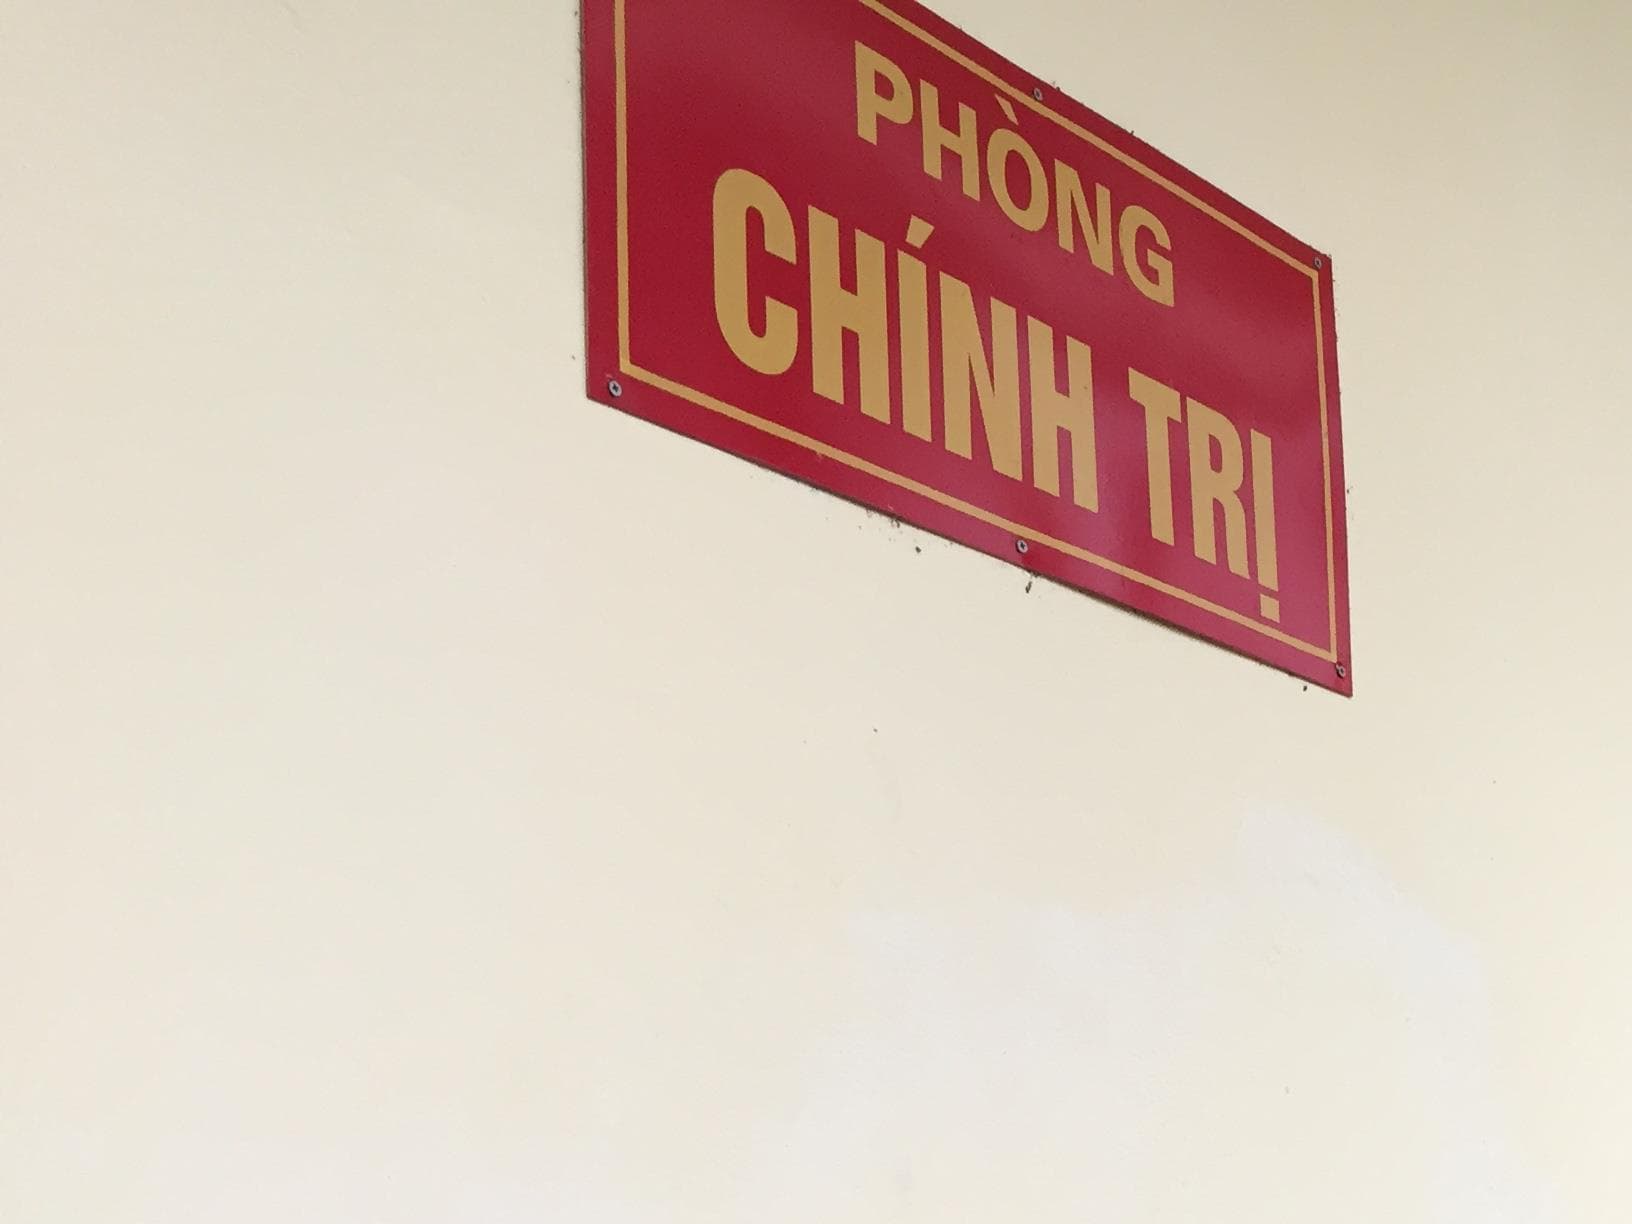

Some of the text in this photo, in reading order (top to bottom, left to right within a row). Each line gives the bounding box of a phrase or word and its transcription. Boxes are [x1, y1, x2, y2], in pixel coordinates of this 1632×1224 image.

[854, 40, 1175, 307] PHÒNG
[712, 167, 1281, 623] CHÍNH TRỊ
